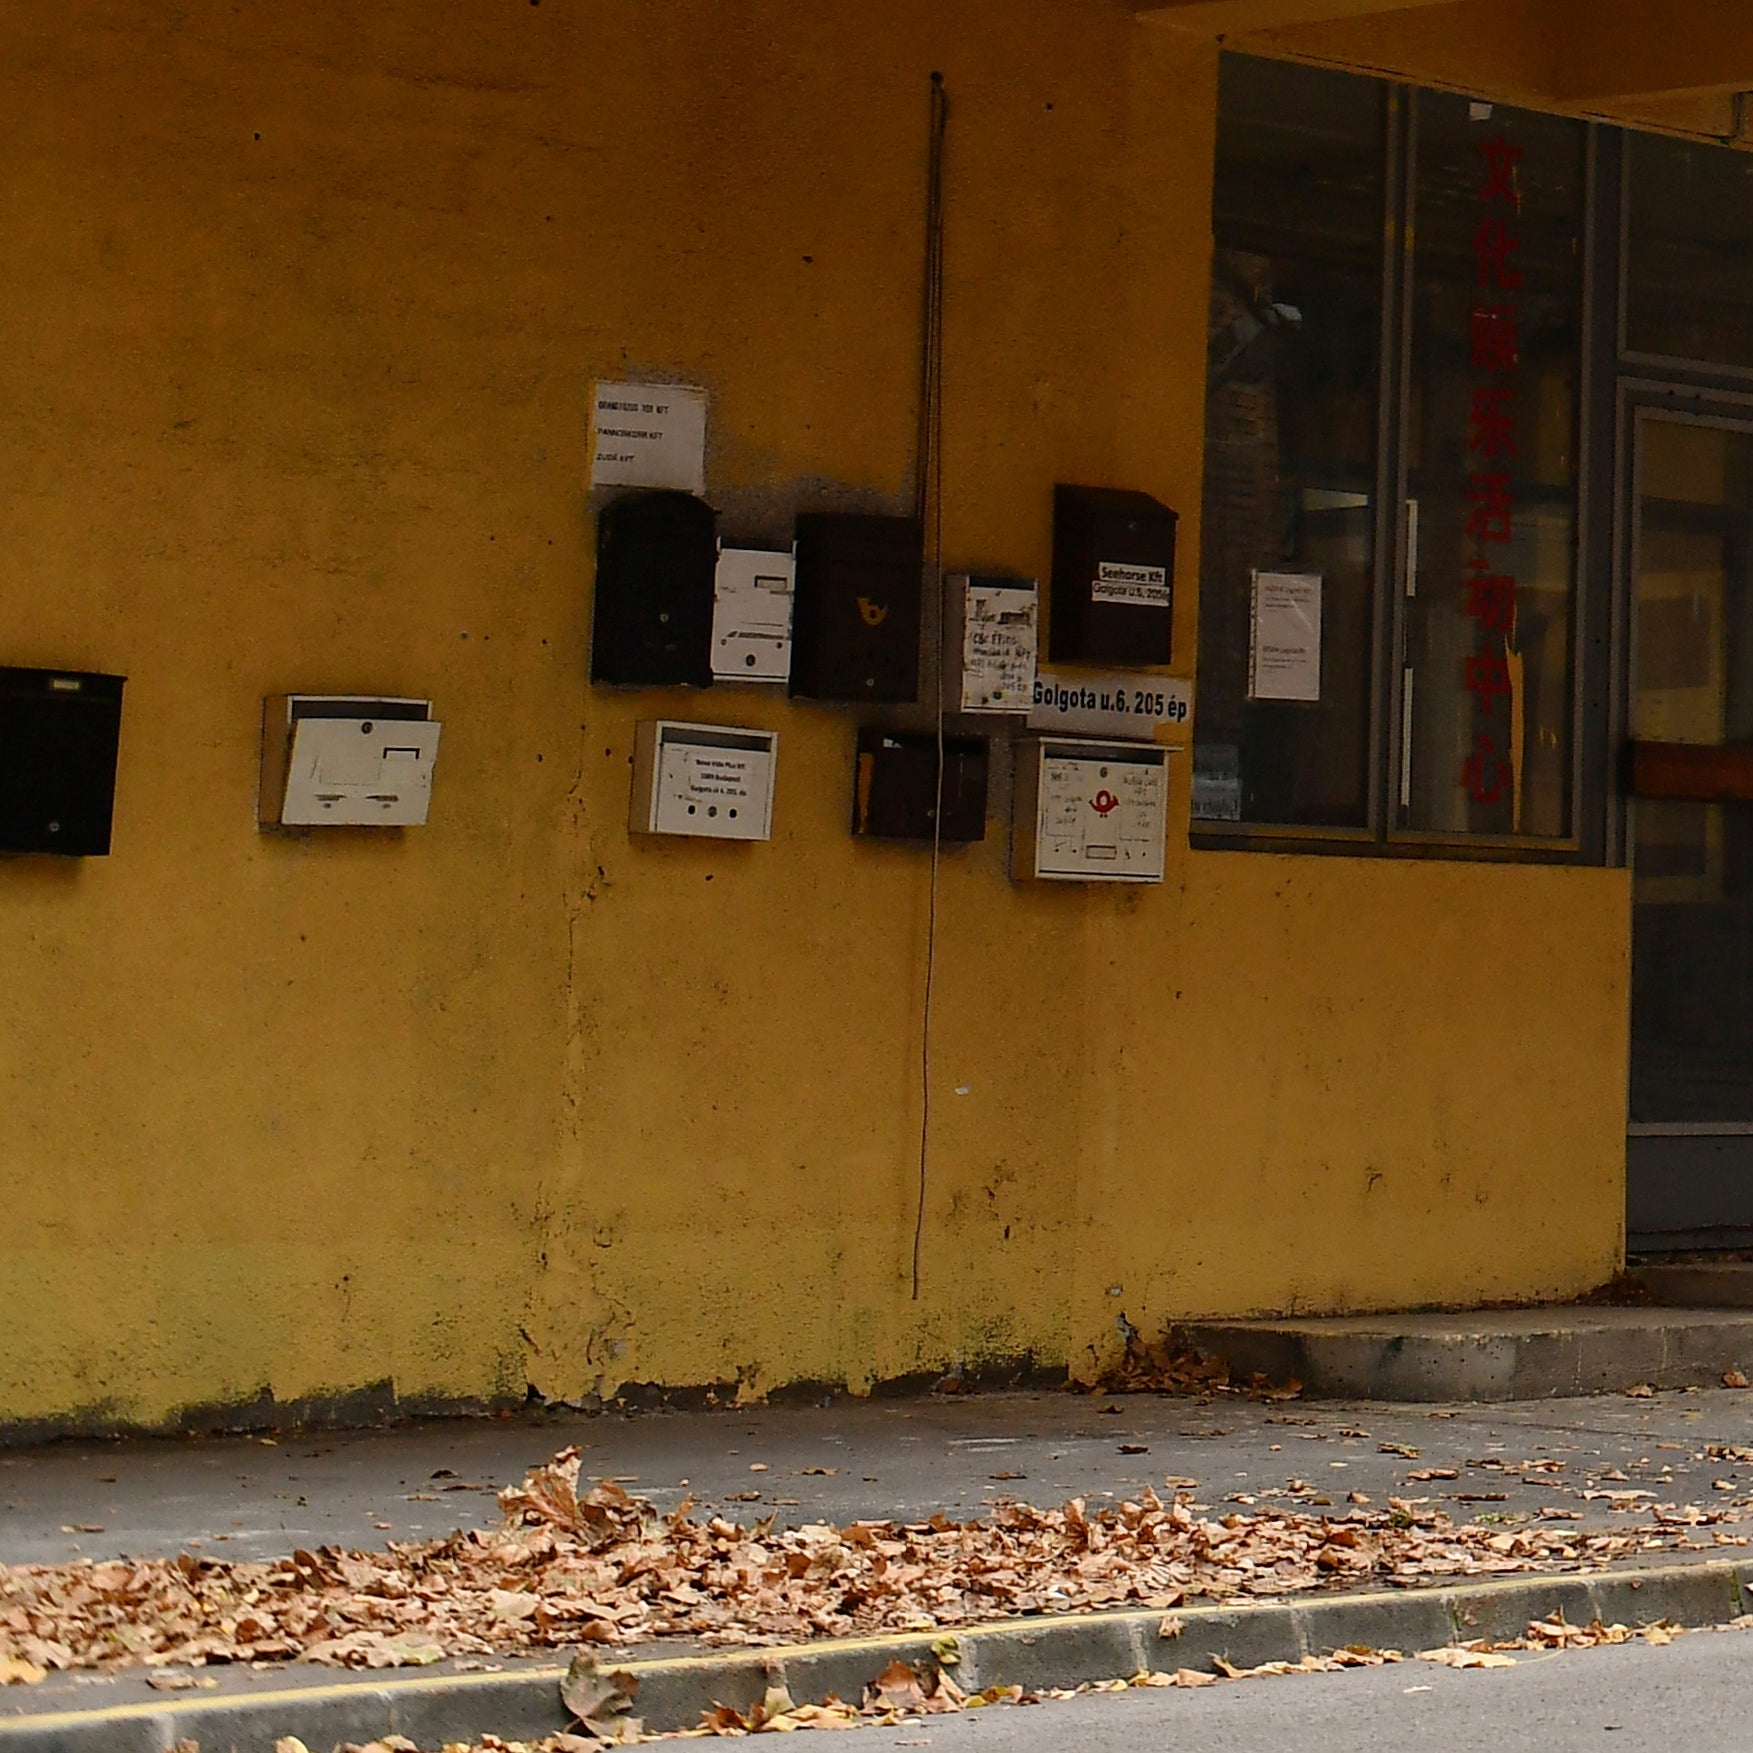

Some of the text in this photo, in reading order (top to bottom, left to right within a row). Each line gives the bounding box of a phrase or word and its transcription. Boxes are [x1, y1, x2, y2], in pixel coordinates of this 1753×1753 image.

[1033, 681, 1096, 713] Golgota
[1100, 689, 1130, 713] u.6.
[1134, 691, 1163, 716] 205
[1167, 694, 1187, 723] ép
